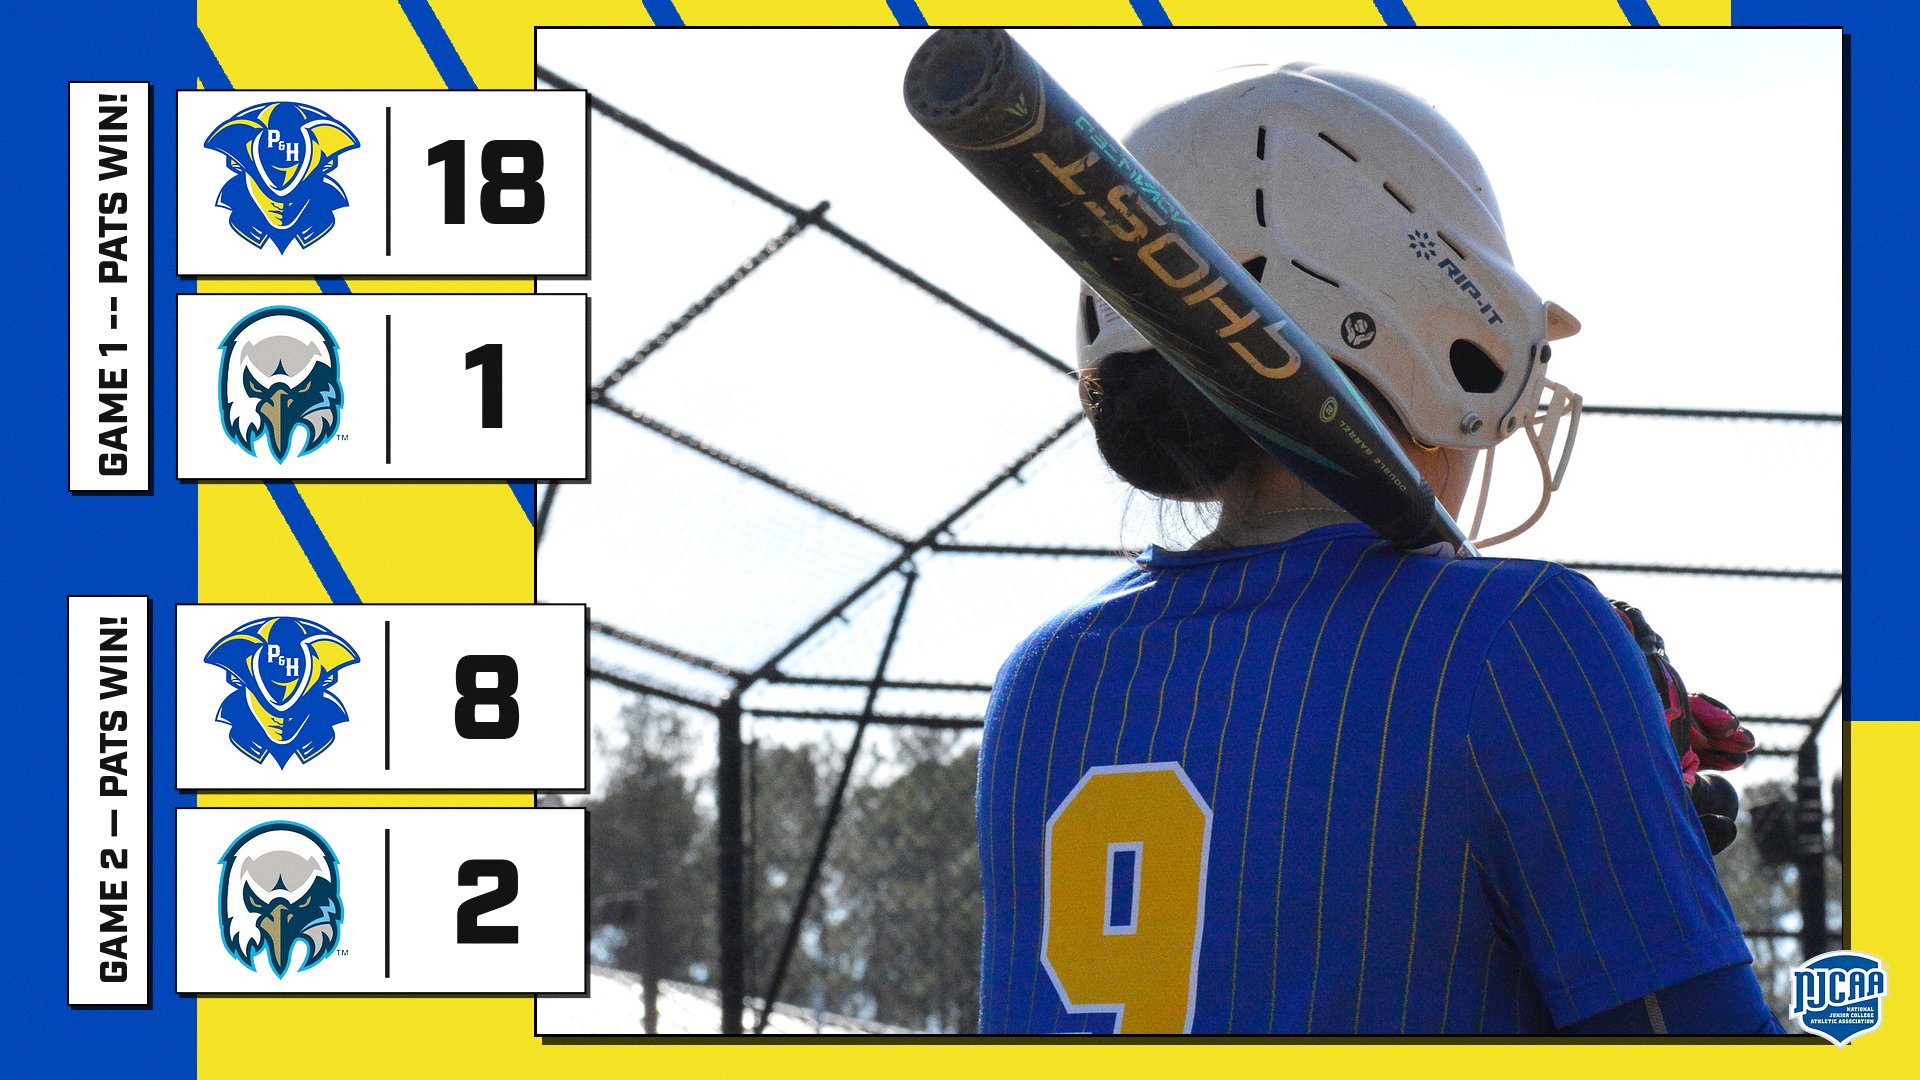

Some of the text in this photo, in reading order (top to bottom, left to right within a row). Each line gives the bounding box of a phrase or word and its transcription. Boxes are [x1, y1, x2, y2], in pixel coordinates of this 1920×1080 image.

[1075, 115, 1191, 225] ADVANCED
[1032, 149, 1302, 380] GHOST
[1437, 257, 1504, 326] RIP-IT
[1339, 419, 1407, 491] DOUBLE BARREL
[1040, 761, 1214, 1034] 9
